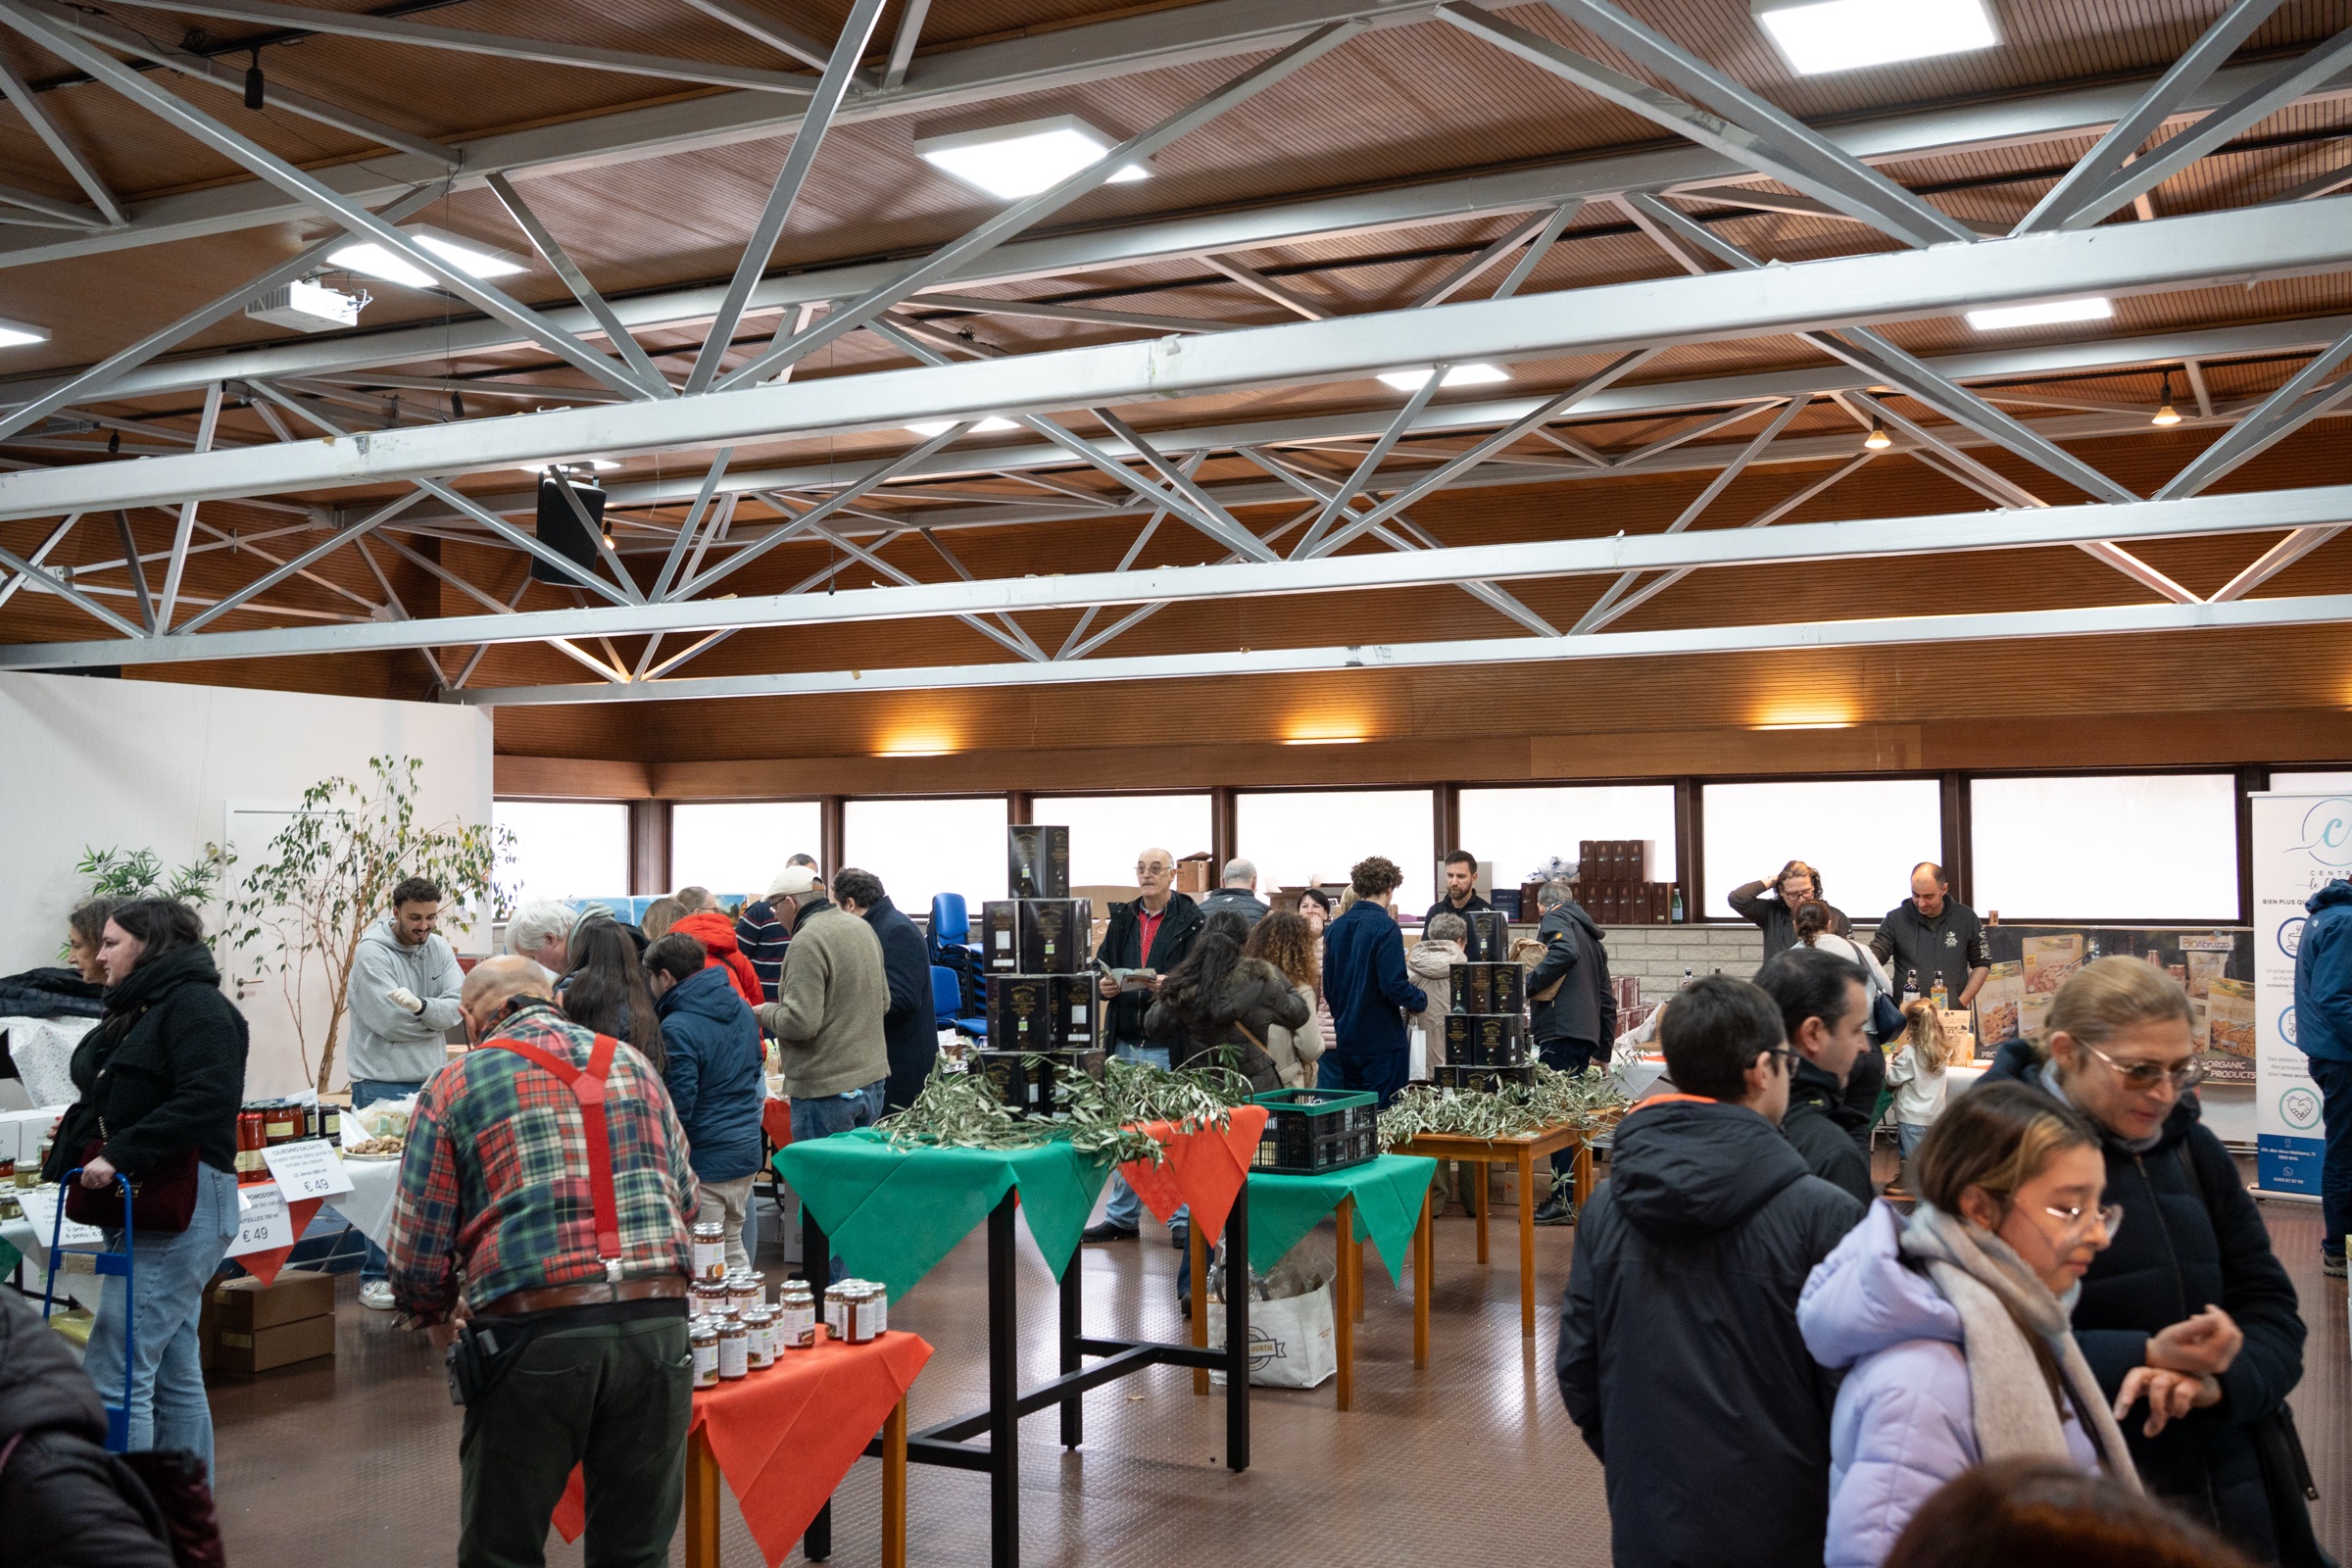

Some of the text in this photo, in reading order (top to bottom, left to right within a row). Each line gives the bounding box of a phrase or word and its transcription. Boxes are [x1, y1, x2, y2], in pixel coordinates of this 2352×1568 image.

[2182, 938, 2230, 949] BioAbruzzo
[1981, 1051, 1997, 1059] PRO
[2206, 1060, 2246, 1069] ORGANIC
[2210, 1069, 2256, 1079] PRODUCTS
[304, 1179, 329, 1193] € 49
[246, 1191, 279, 1200] POMODORO
[239, 1216, 265, 1225] UTEILLES
[242, 1227, 269, 1244] € 49
[1249, 1344, 1273, 1353] -UURTJE
